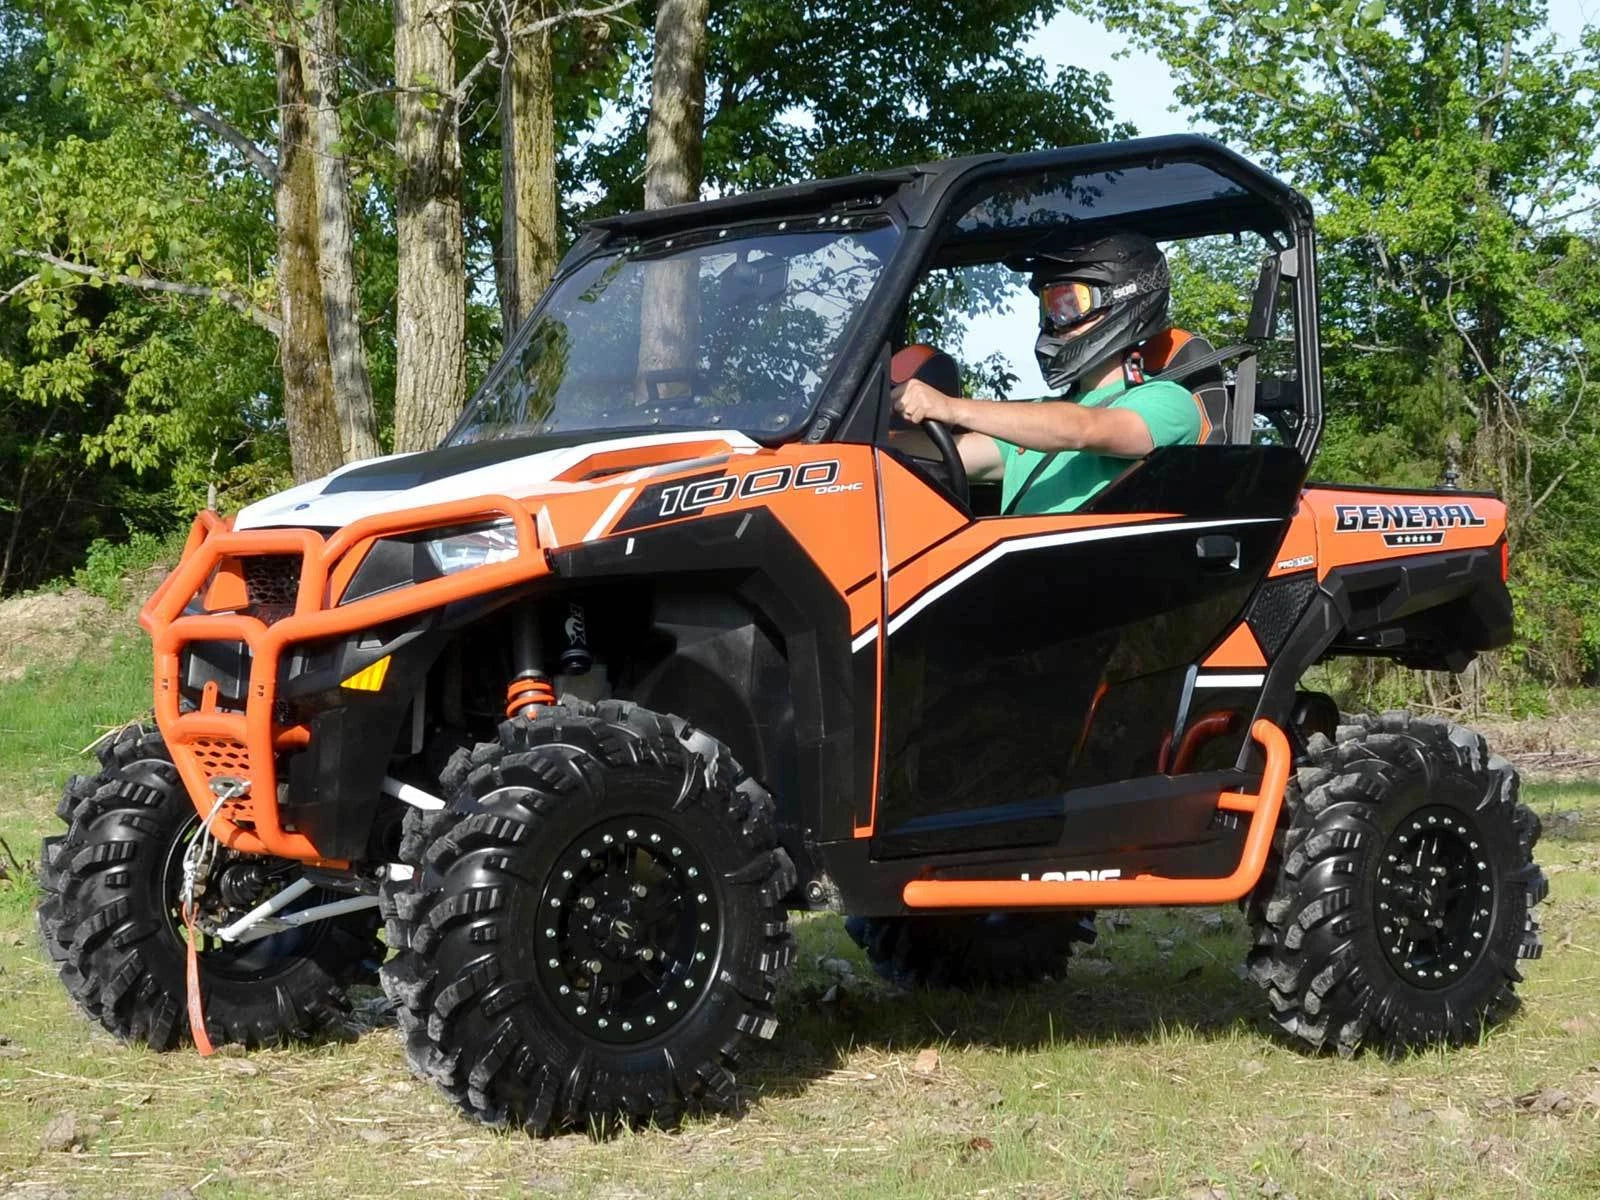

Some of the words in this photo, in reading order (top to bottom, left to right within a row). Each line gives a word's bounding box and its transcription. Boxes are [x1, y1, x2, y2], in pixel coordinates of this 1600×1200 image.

[659, 460, 840, 516] 1000
[815, 482, 864, 495] DOHC
[1334, 503, 1487, 532] GENERAL
